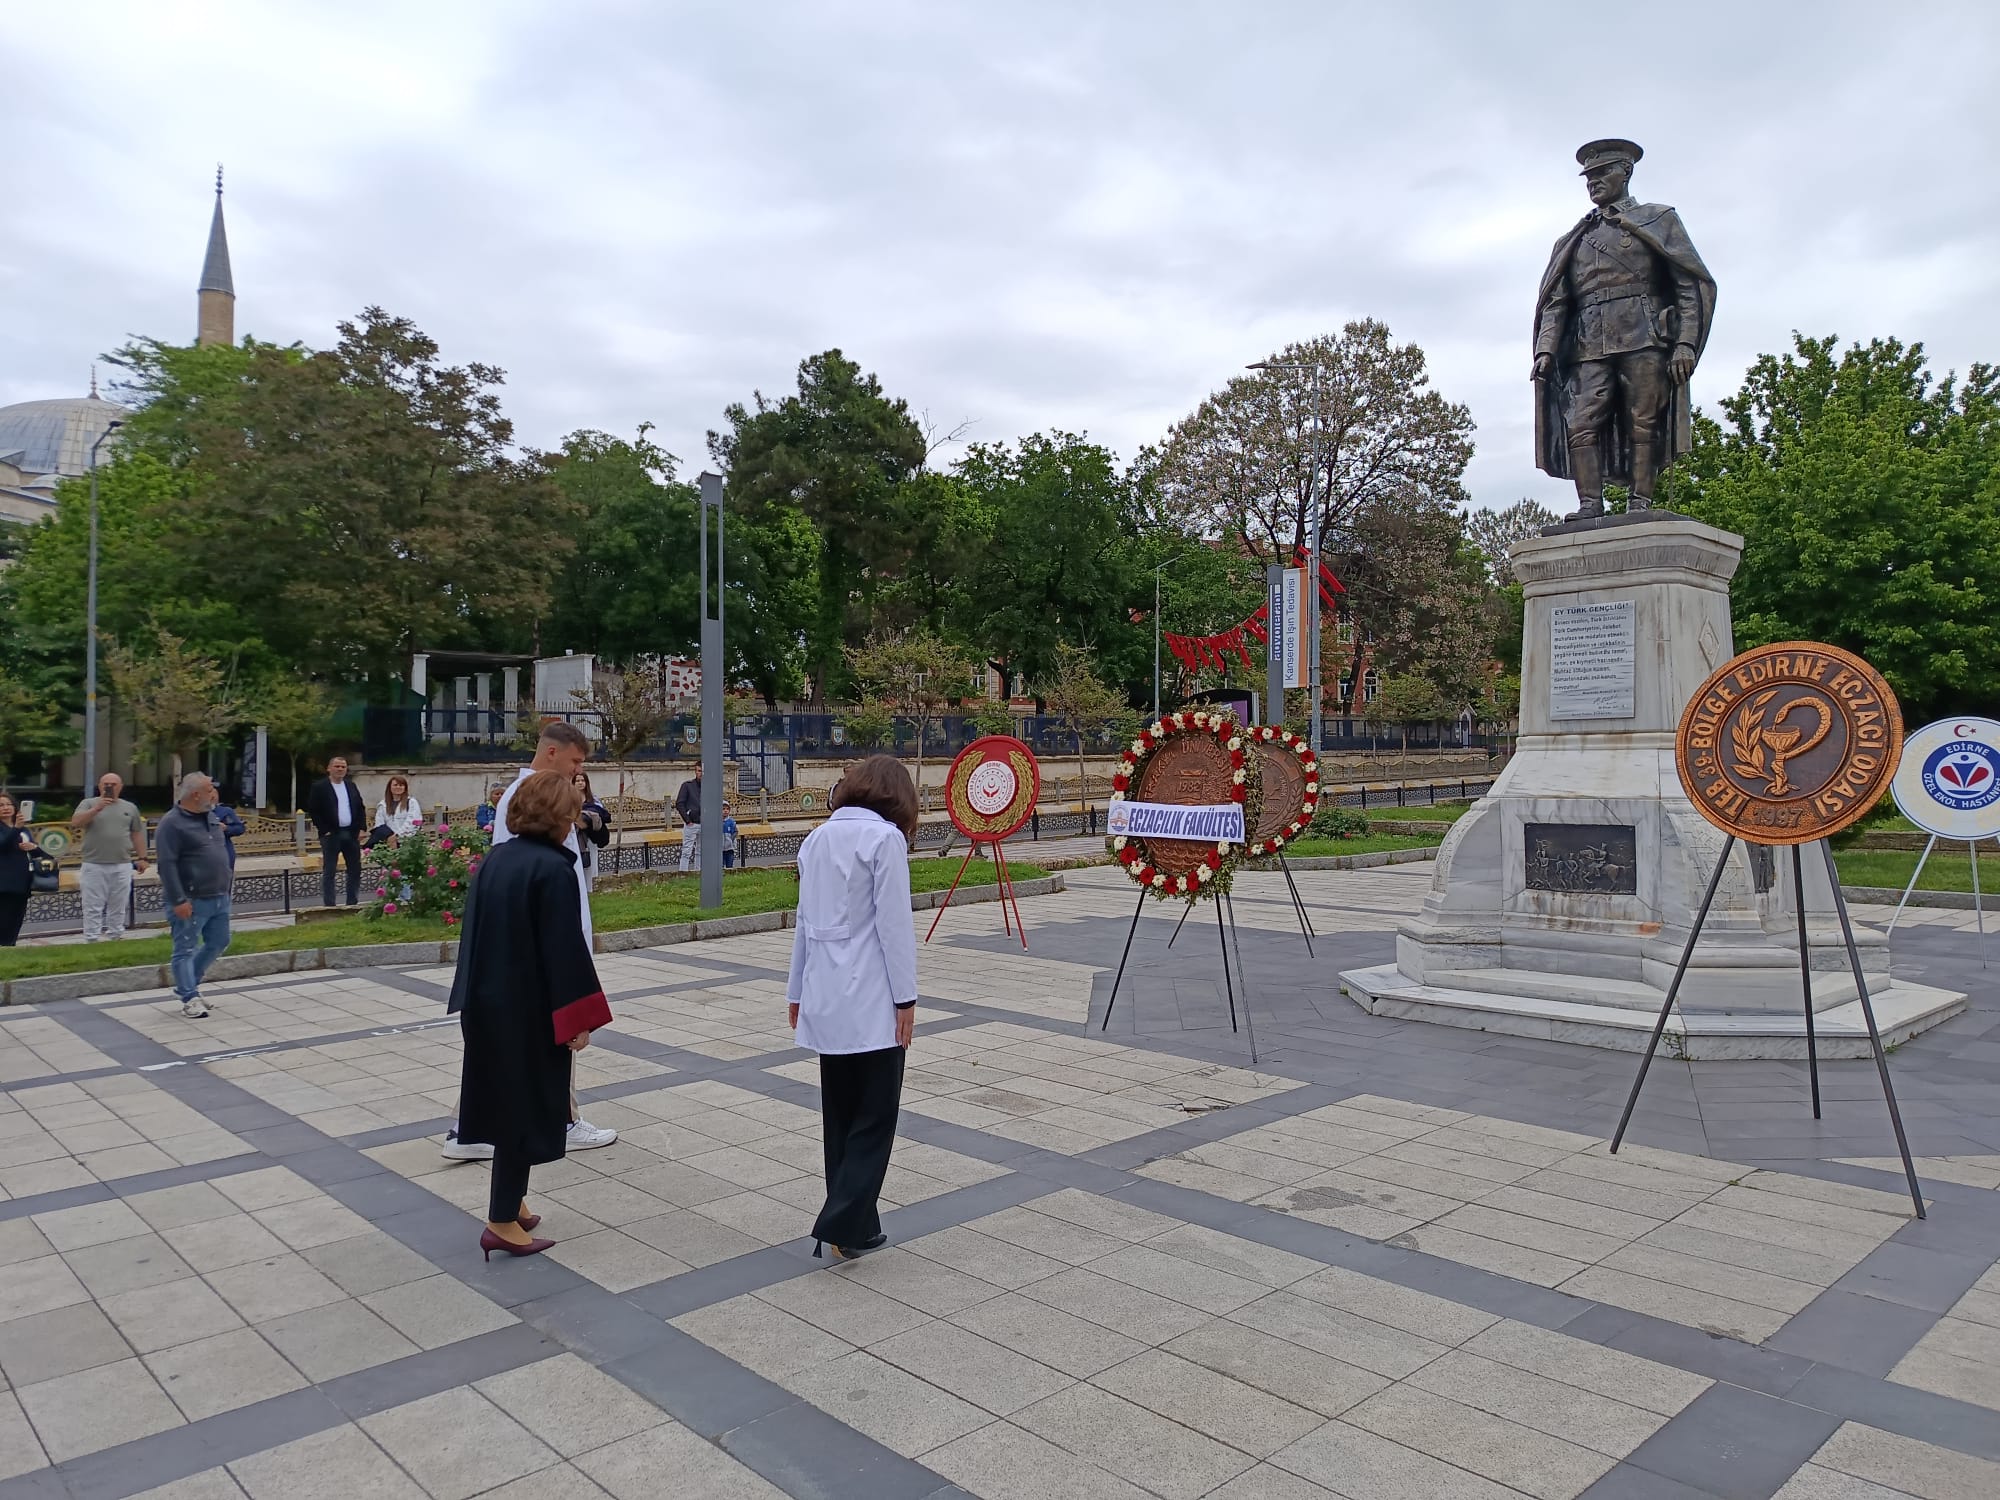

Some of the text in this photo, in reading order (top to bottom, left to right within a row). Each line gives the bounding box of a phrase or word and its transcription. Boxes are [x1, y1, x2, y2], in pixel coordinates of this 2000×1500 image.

[1285, 578, 1297, 681] Kanserde Işın Tedavisi
[1734, 656, 1829, 690] EDİRNE
[1828, 668, 1885, 749] ECZACI
[1945, 742, 1990, 757] EDİRNE
[1177, 780, 1201, 792] 1982
[1704, 778, 1746, 818] TEB
[1815, 753, 1878, 818] ODASI
[1923, 772, 1937, 793] ÖZEL
[1934, 792, 1957, 807] EKOL
[1128, 807, 1185, 834] ECZACILIK
[1182, 807, 1243, 839] FAKÜLTESİ
[1752, 807, 1802, 828] 1997
